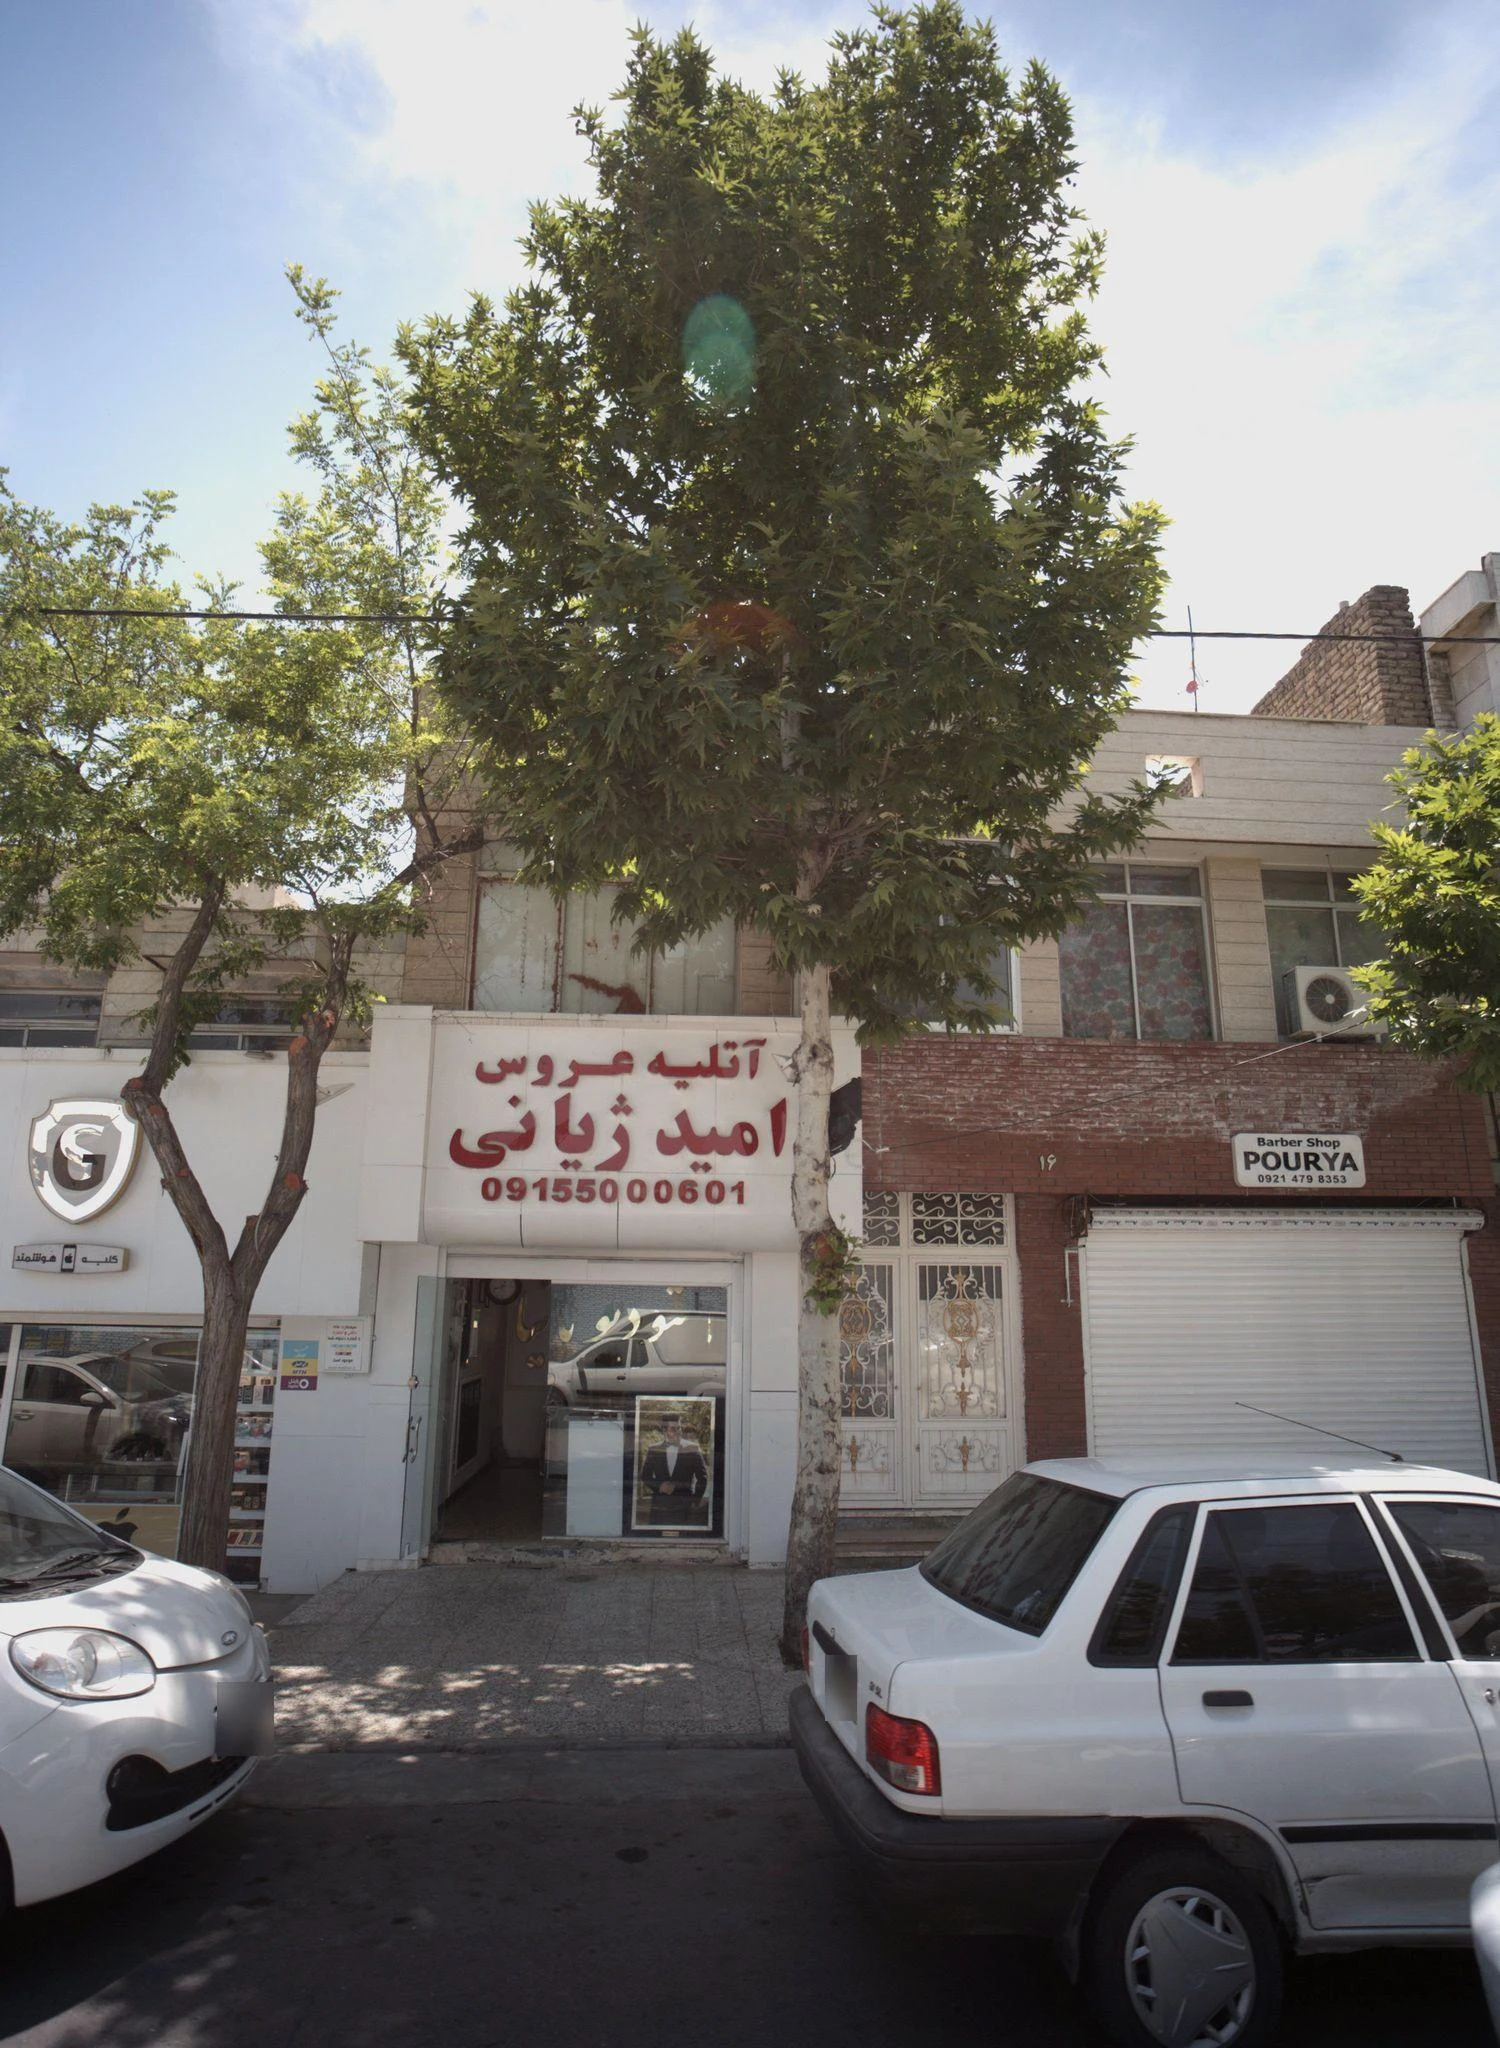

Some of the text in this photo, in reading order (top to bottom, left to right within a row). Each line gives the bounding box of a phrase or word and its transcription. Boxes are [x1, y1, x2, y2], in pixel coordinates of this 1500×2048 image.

[475, 1038, 768, 1089] آتلیه عروس
[449, 1092, 789, 1173] امید ژیانی
[1256, 1136, 1341, 1151] Barber Shop
[1243, 1150, 1361, 1173] POURYA
[481, 1176, 746, 1205] 09155000601
[1257, 1174, 1348, 1185] 0921 479 8353
[81, 1254, 119, 1267] کلبه
